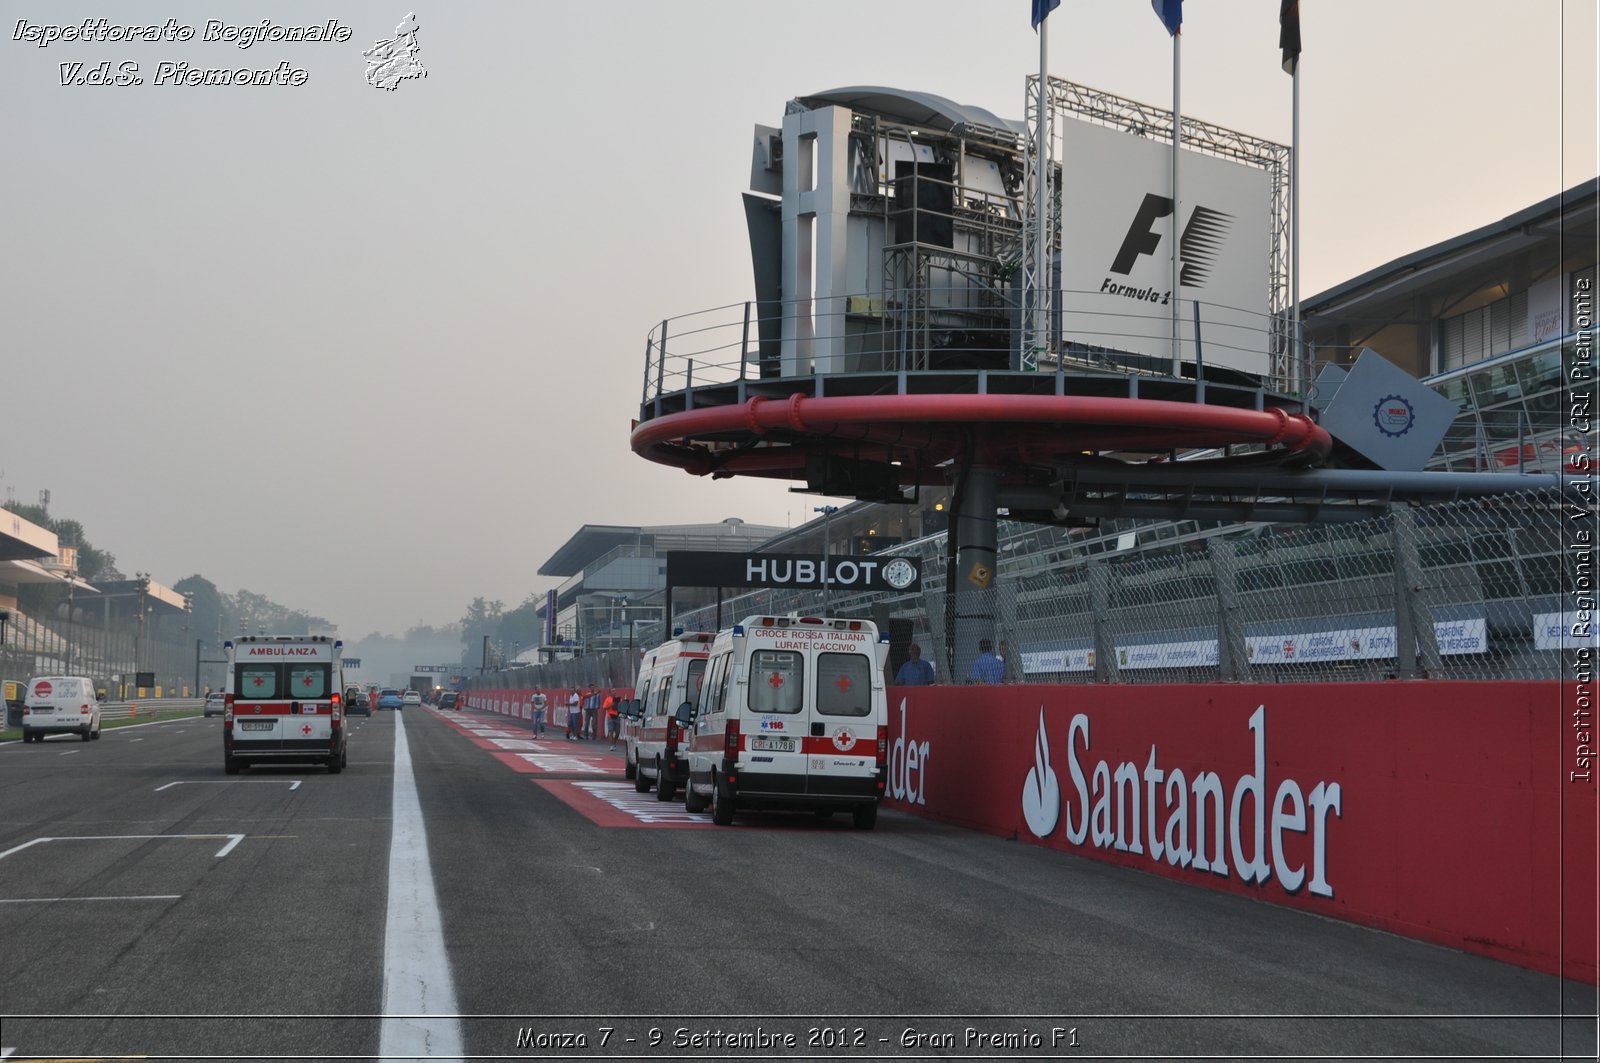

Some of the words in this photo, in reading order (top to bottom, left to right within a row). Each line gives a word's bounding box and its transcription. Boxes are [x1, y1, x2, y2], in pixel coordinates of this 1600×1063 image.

[1100, 278, 1160, 303] Formula
[1161, 291, 1171, 305] 1
[746, 559, 877, 585] HUBLOT
[755, 630, 787, 639] CROCE
[792, 631, 823, 640] ROSSA
[827, 632, 866, 642] ITALIANA
[775, 641, 809, 649] LURATE
[813, 643, 856, 652] CACCIVIO
[769, 721, 784, 729] 118
[1066, 704, 1343, 898] Santander
